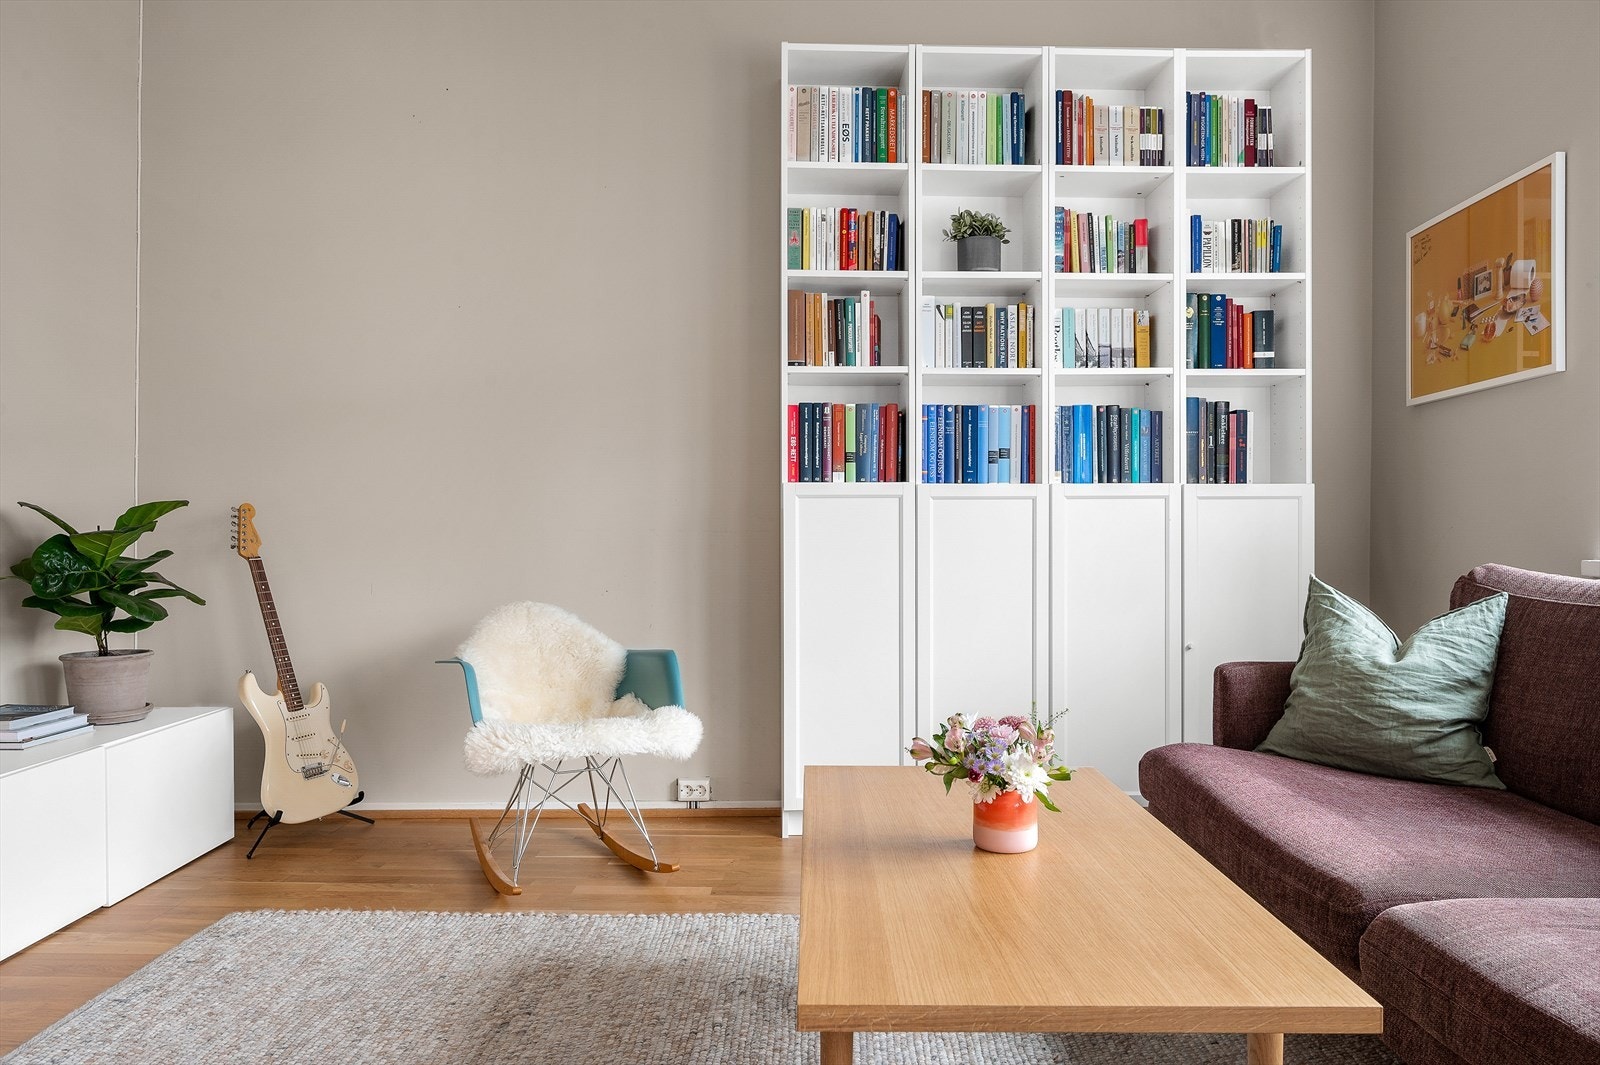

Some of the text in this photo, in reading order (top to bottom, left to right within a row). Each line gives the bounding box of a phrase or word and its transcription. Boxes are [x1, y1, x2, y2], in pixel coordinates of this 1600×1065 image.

[1202, 238, 1212, 268] PAPILLON
[930, 453, 936, 463] OG
[937, 448, 944, 459] OG
